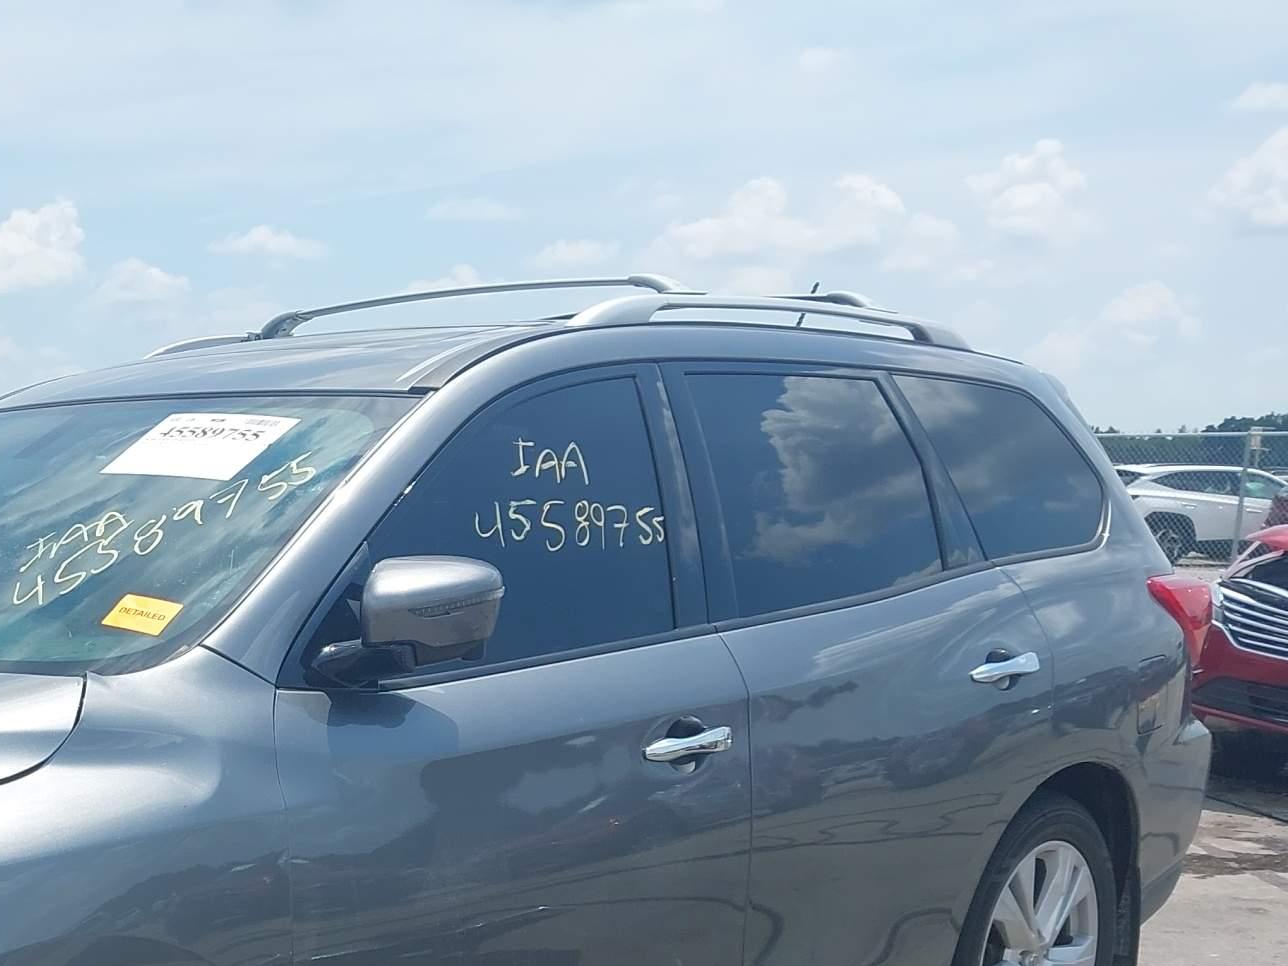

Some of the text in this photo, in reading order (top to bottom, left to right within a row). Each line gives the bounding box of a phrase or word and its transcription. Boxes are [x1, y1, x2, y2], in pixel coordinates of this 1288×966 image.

[160, 426, 265, 441] 45589755
[510, 437, 589, 485] IAA
[20, 511, 134, 573] IAA
[475, 499, 666, 552] 45589755
[118, 606, 166, 621] DETAILED
